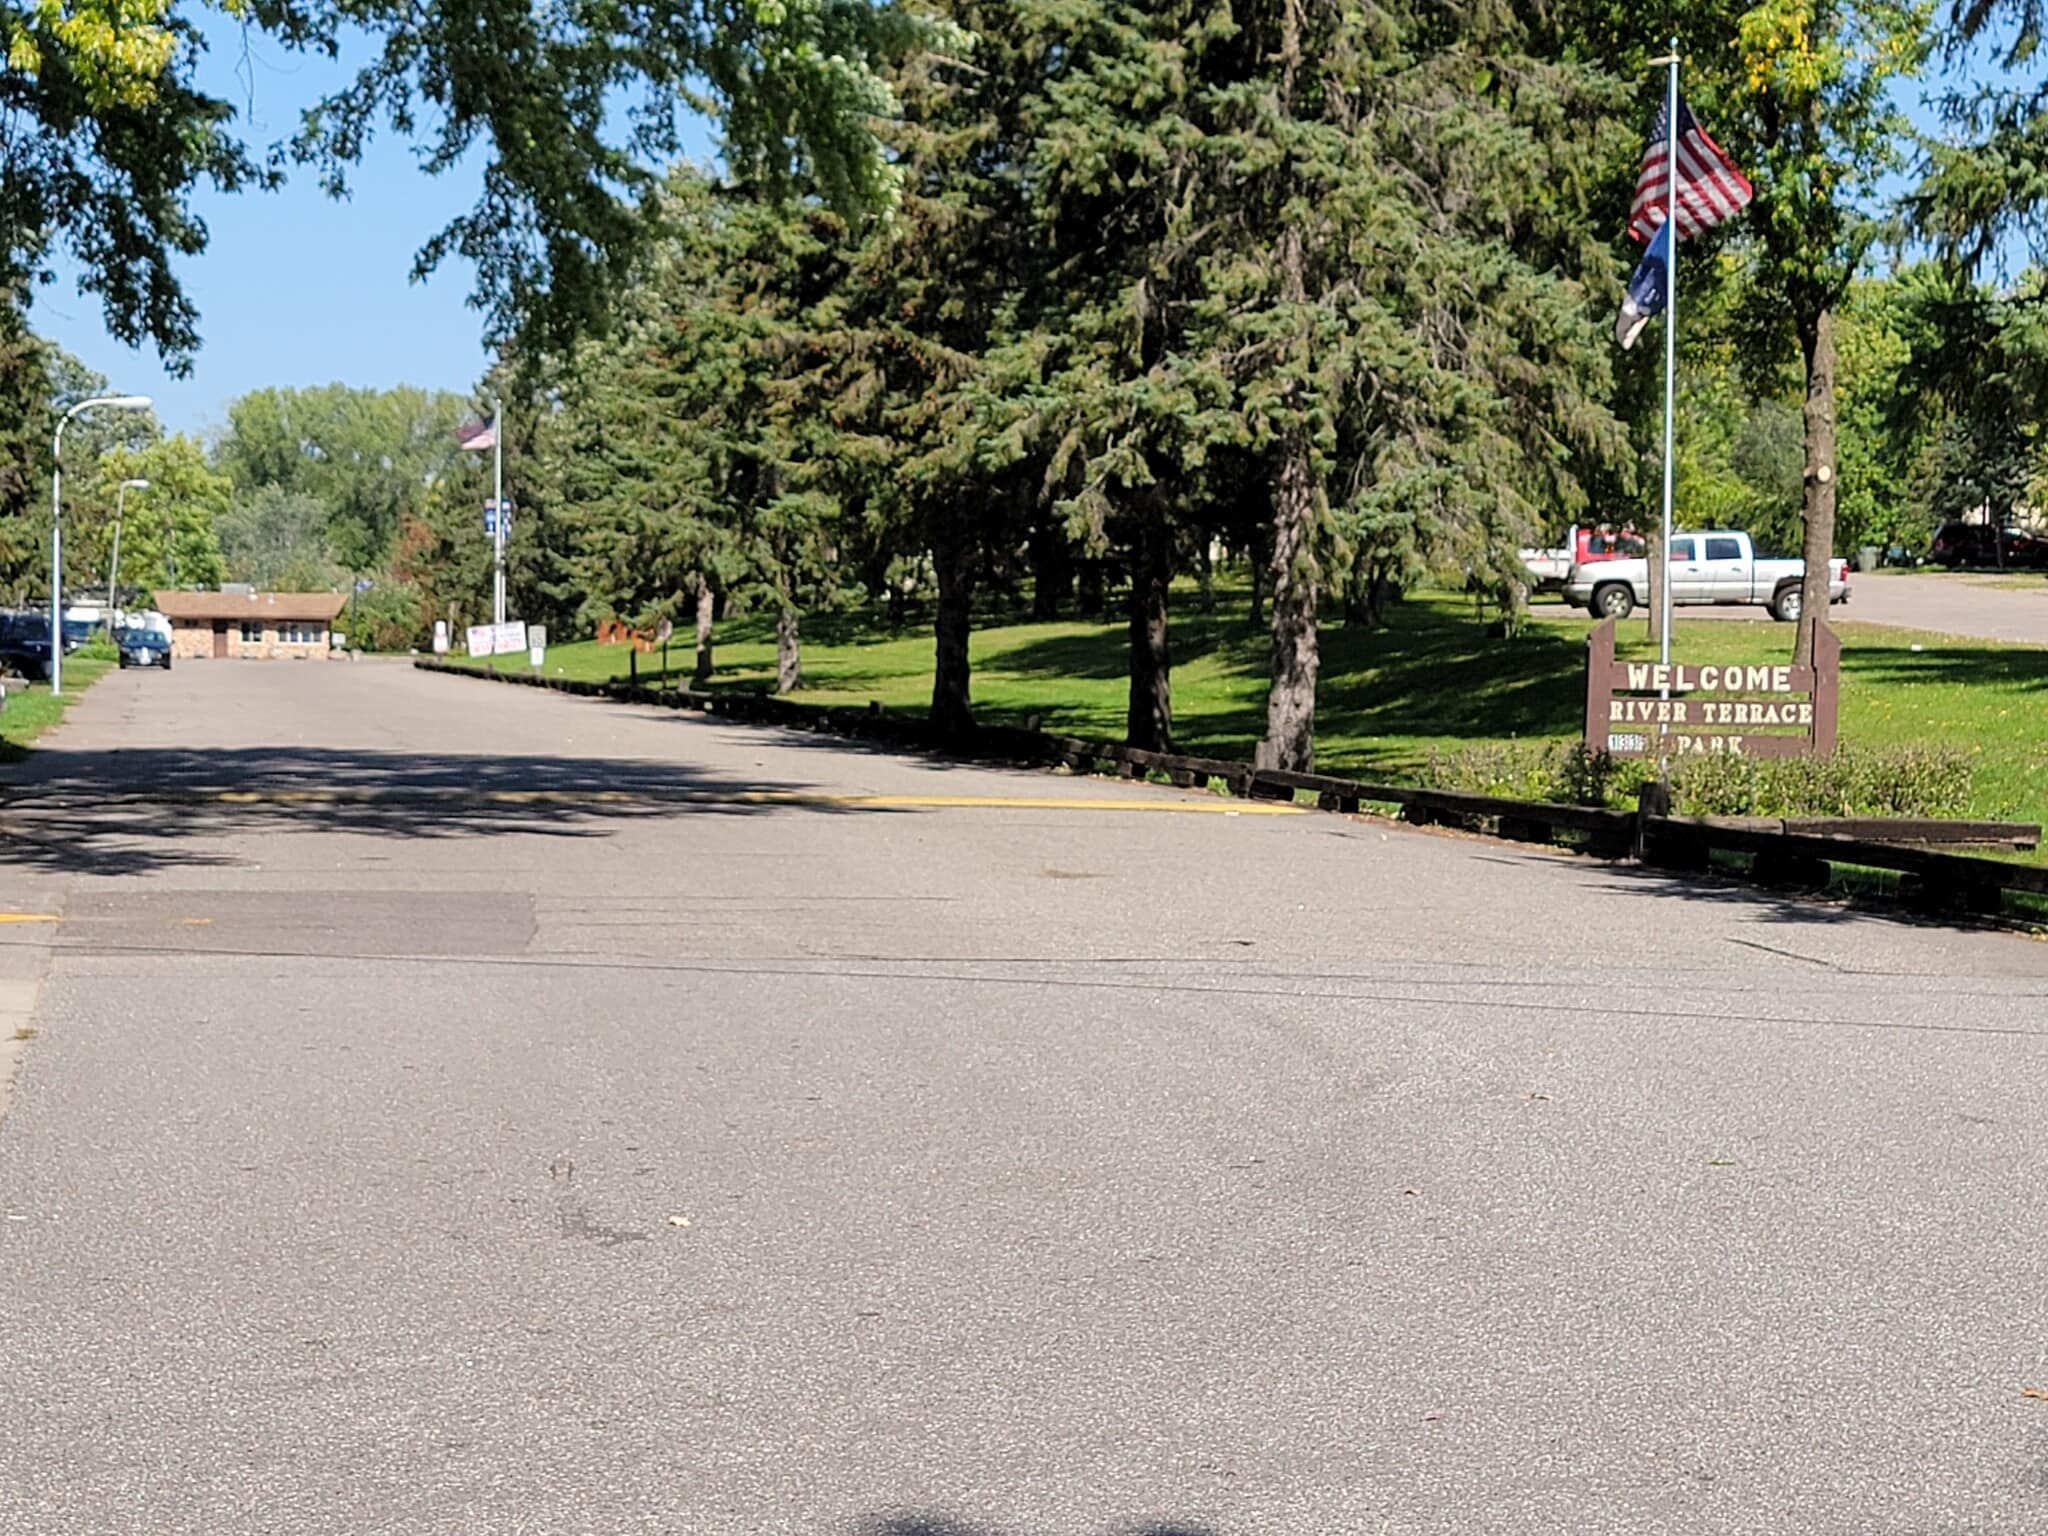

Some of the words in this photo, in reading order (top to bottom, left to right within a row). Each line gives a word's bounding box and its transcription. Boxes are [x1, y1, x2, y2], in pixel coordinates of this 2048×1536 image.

[1627, 665, 1791, 690] WELCOME
[1610, 701, 1687, 721] RIVER
[1702, 703, 1813, 723] TERRACE
[1676, 735, 1743, 755] PARK
